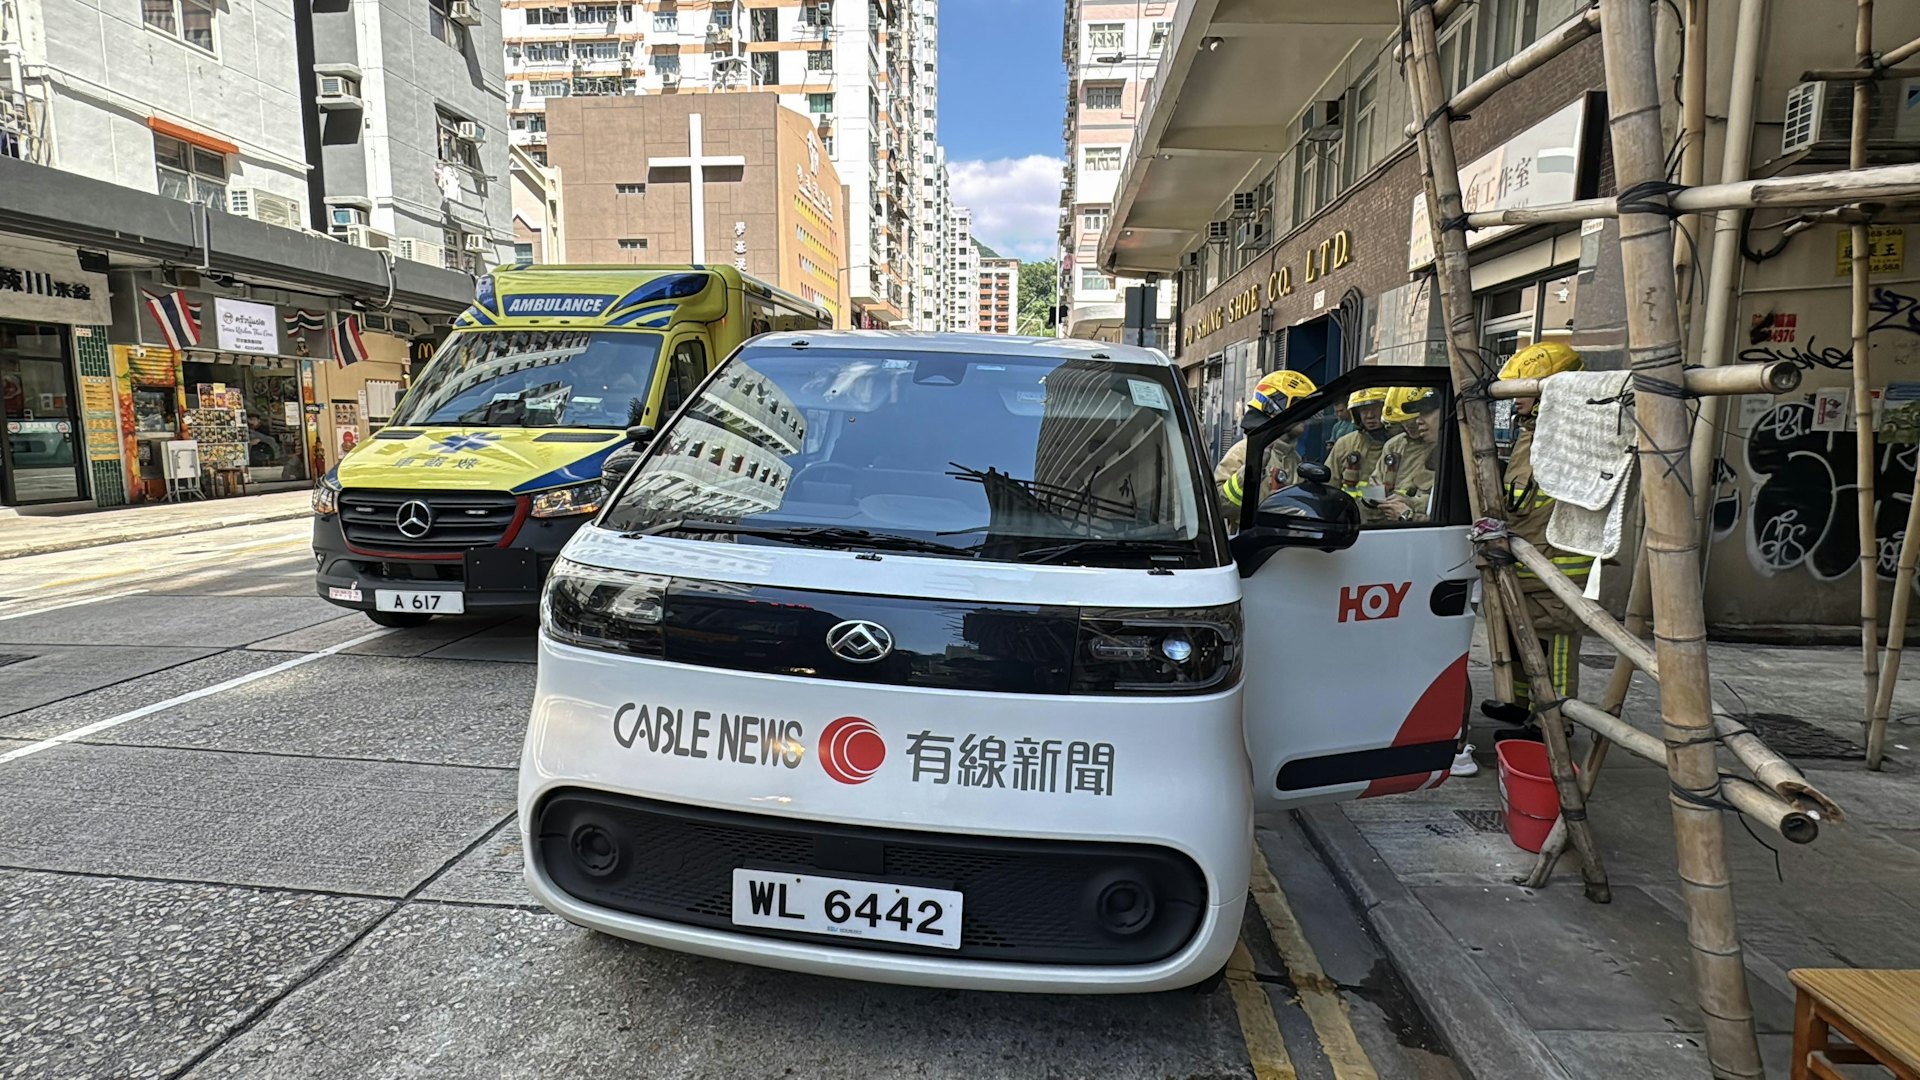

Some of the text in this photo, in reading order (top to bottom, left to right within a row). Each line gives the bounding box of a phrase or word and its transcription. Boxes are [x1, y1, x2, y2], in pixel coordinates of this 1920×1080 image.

[508, 298, 604, 312] AMBULANCE
[1197, 306, 1222, 339] SHING
[1228, 284, 1259, 323] SHOE
[1305, 230, 1349, 283] LTD.
[394, 594, 442, 610] A 617
[1338, 581, 1413, 623] HOY
[613, 702, 806, 769] CABLE NEWS
[905, 730, 1115, 796] 有線新聞
[749, 880, 944, 936] WL 6442
